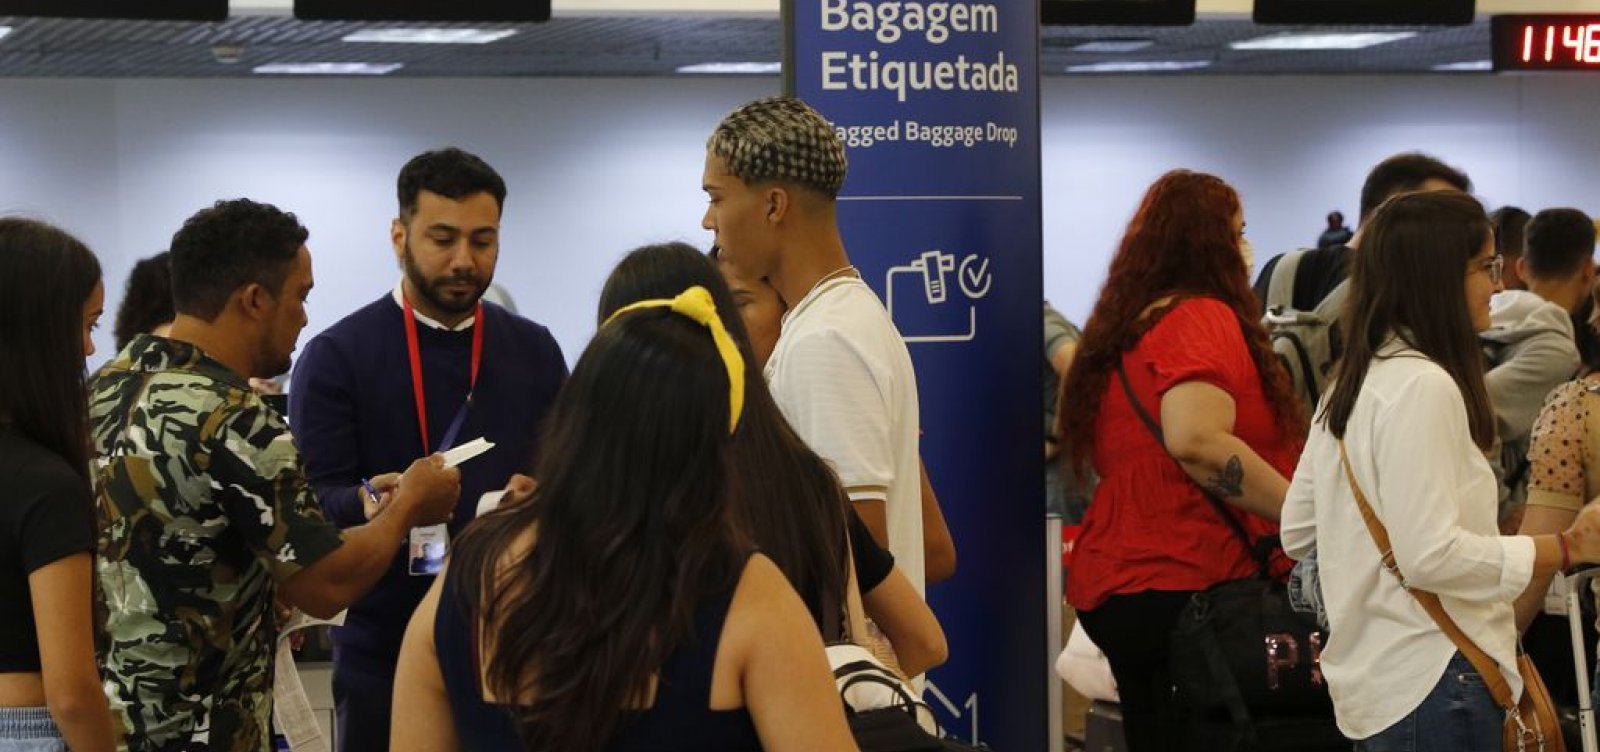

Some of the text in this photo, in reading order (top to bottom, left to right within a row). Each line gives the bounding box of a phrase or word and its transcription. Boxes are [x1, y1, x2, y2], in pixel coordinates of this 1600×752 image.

[821, 0, 998, 43] Bagagem
[821, 50, 1018, 102] Etiquetada
[828, 120, 1018, 148] agged Baggage Drop
